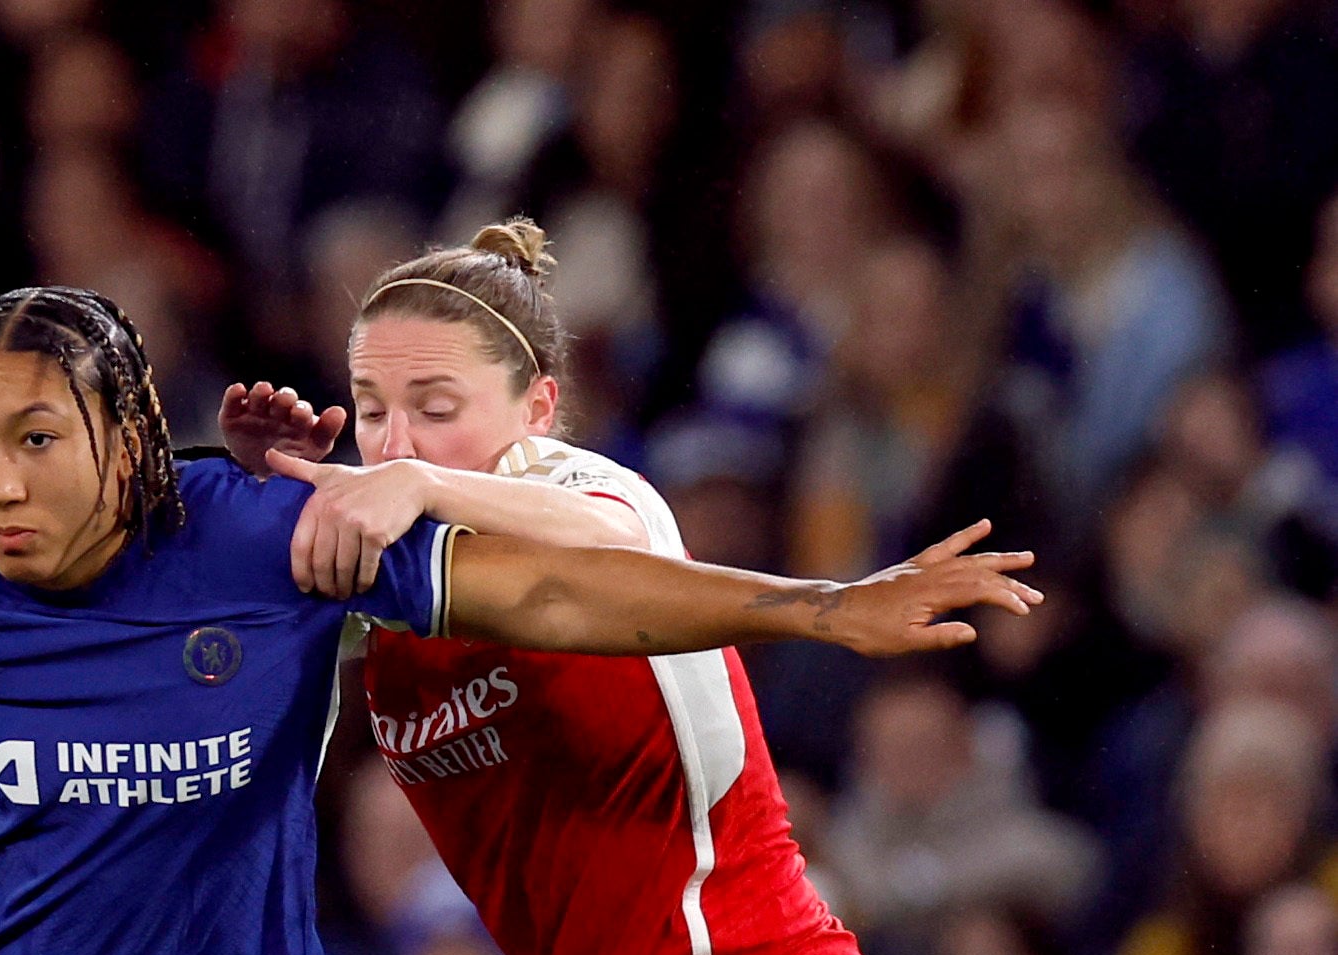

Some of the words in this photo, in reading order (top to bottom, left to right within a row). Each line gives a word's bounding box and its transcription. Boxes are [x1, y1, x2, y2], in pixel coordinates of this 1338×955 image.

[367, 666, 518, 754] mirates
[57, 727, 252, 773] INFINITE
[416, 725, 509, 778] BETTER
[59, 758, 252, 807] ATHLETE
